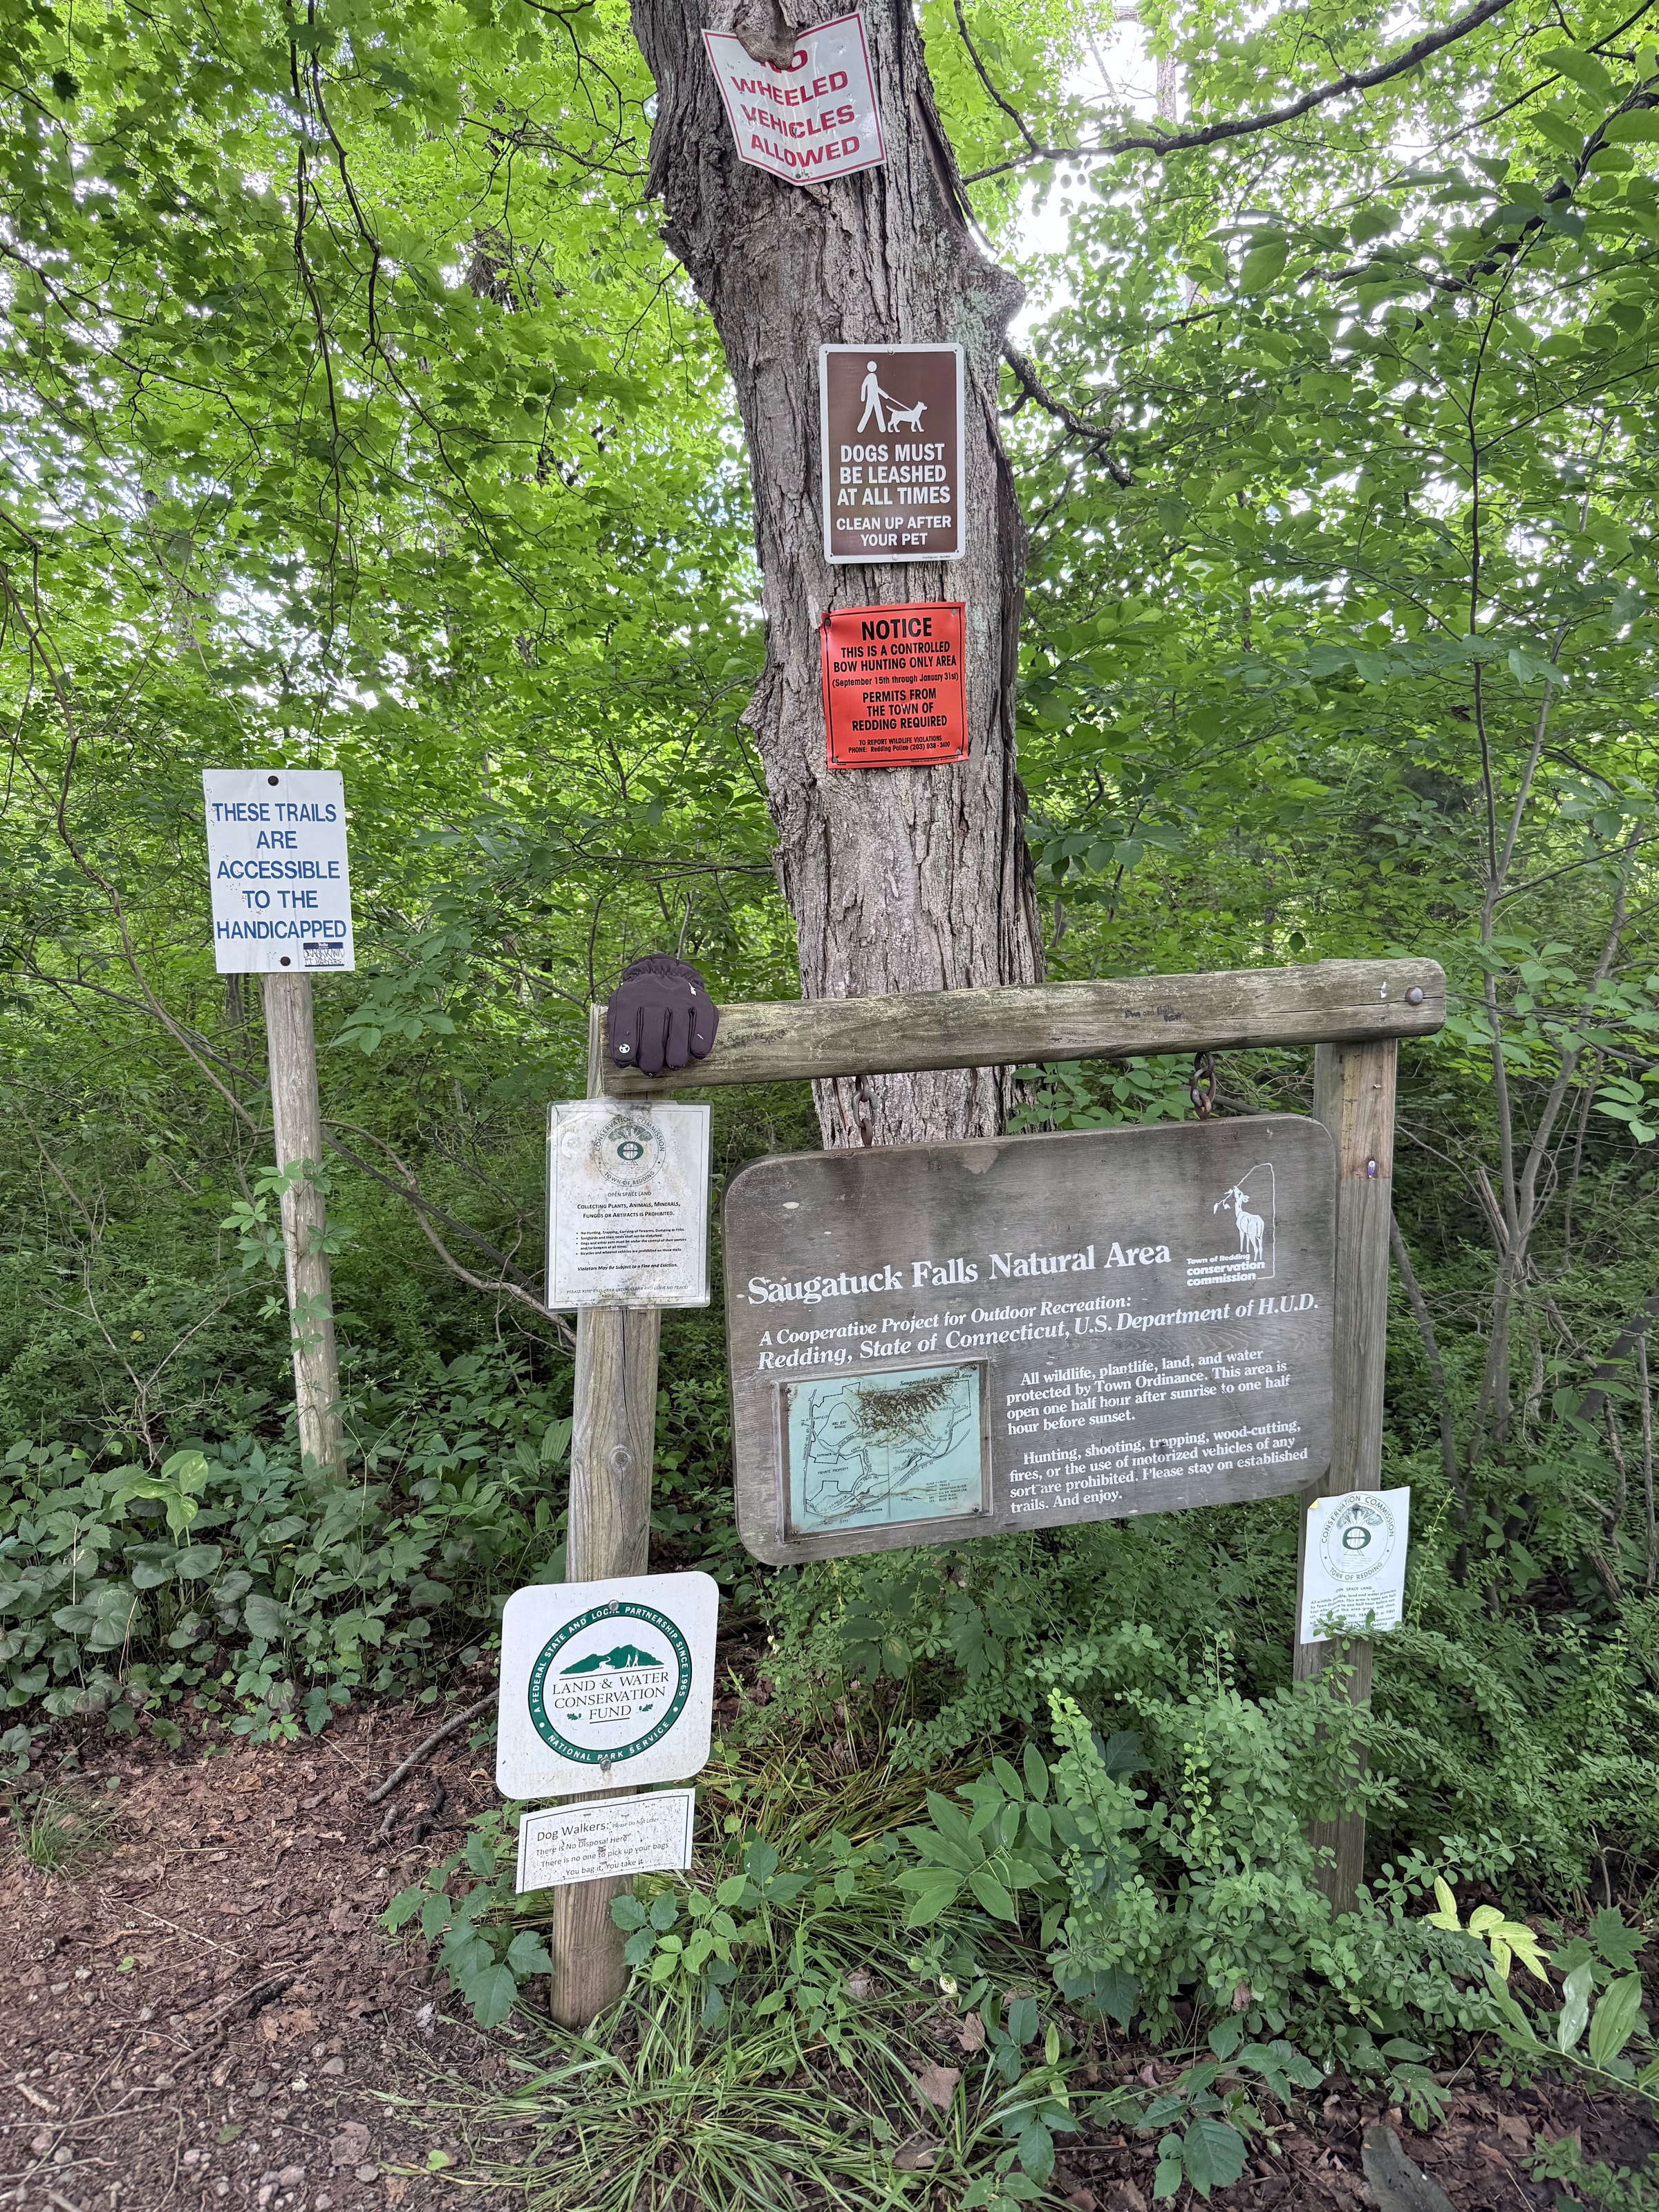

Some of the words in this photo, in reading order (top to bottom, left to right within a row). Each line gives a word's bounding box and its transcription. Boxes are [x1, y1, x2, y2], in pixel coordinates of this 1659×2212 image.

[731, 71, 848, 106] WHEELED
[740, 104, 854, 139] VEHICLES
[751, 134, 860, 168] ALLOWED
[841, 444, 888, 462] DOGS
[895, 443, 944, 462] MUST
[840, 467, 863, 484] BE
[868, 465, 946, 483] LEASHED
[836, 488, 857, 505] AT
[862, 487, 893, 505] ALL
[897, 486, 950, 505] TIMES
[836, 518, 881, 530] CLEAN
[885, 517, 903, 529] UP
[907, 516, 951, 529] AFTER
[861, 534, 897, 546] YOUR
[901, 533, 928, 545] PET
[861, 617, 932, 641] NOTICE
[841, 646, 863, 658] THIS
[867, 646, 877, 657] IS
[881, 645, 888, 656] A
[890, 641, 950, 655] CONTROLLED
[834, 661, 857, 673] BOW
[861, 658, 906, 671] HUNTING
[910, 657, 933, 668] ONLY
[936, 655, 957, 666] AREA
[832, 675, 872, 688] (September
[875, 675, 890, 684] 15th
[892, 673, 918, 684] through
[919, 673, 943, 683] January
[944, 672, 959, 681] 31st)
[863, 690, 906, 703] PERMITS
[910, 688, 936, 701] FROM
[867, 704, 885, 717] THE
[888, 703, 919, 715] TOWN
[921, 702, 934, 713] OF
[852, 718, 897, 731] REDDING
[900, 715, 947, 729] REQUIRED
[212, 803, 270, 822] THESE
[275, 803, 337, 822] TRAILS
[256, 830, 298, 849] ARE
[216, 860, 340, 879] ACCESSIBLE
[243, 890, 270, 908] TO
[277, 890, 319, 908] THE
[216, 920, 346, 939] HANDICAPPED
[748, 1264, 903, 1305] Saugatuck
[911, 1257, 978, 1288] Falls
[988, 1245, 1096, 1279] Natural
[1104, 1241, 1172, 1268] Area
[1186, 1261, 1266, 1275] conservation
[1186, 1272, 1257, 1286] commission
[759, 1331, 772, 1347] A
[776, 1321, 877, 1344] Cooperative
[881, 1315, 939, 1333] Project
[944, 1311, 966, 1327] for
[971, 1306, 1035, 1324] Outdoor
[1040, 1295, 1132, 1316] Recreation:
[758, 1346, 854, 1371] Redding,
[860, 1338, 912, 1359] State
[917, 1333, 937, 1353] of
[945, 1322, 1069, 1349] Connecticut,
[1074, 1316, 1112, 1335] U.S.
[1116, 1304, 1230, 1331] Department
[1235, 1298, 1255, 1318] of
[1257, 1293, 1319, 1315] H.U.D.
[1020, 1371, 1040, 1386] All
[1043, 1367, 1096, 1383] wildlife,
[1099, 1360, 1159, 1379] plantlife,
[1161, 1356, 1194, 1371] land,
[1198, 1352, 1222, 1366] and
[1226, 1349, 1264, 1362] water
[1006, 1385, 1071, 1406] protected
[1075, 1382, 1091, 1398] by
[1094, 1378, 1132, 1394] Town
[1135, 1371, 1208, 1388] Ordinance.
[1211, 1367, 1241, 1380] This
[1244, 1365, 1273, 1376] area
[1276, 1360, 1287, 1373] is
[1006, 1406, 1040, 1421] open
[1043, 1402, 1067, 1415] one
[1071, 1394, 1096, 1411] half
[1100, 1393, 1132, 1407] hour
[1135, 1389, 1165, 1404] after
[1170, 1385, 1217, 1400] sunrise
[1221, 1382, 1235, 1394] to
[1237, 1380, 1262, 1392] one
[1265, 1374, 1291, 1389] half
[1008, 1420, 1039, 1436] hour
[1043, 1416, 1086, 1431] before
[1089, 1409, 1136, 1425] sunset.
[1321, 1495, 1360, 1544] CONSERVATION
[1365, 1497, 1394, 1537] COMMISSION
[1329, 1567, 1342, 1579] TOWN
[1356, 1562, 1383, 1580] REDDING
[568, 1618, 587, 1634] AND
[625, 1606, 678, 1639] PARTNERSHIP
[545, 1633, 566, 1658] STATE
[675, 1642, 688, 1669] SINCE
[532, 1662, 546, 1703] FEDERAL
[552, 1680, 595, 1695] LAND
[601, 1678, 612, 1689] &
[620, 1671, 669, 1687] WATER
[679, 1673, 688, 1697] 1965
[554, 1686, 666, 1709] CONSERVATION
[589, 1705, 632, 1720] FUND
[548, 1734, 591, 1761] NATIONAL
[597, 1750, 624, 1760] PARK
[629, 1721, 669, 1754] SERVICE
[537, 1830, 559, 1841] Dog
[561, 1821, 609, 1836] Walkers:
[536, 1847, 556, 1856] There
[579, 1837, 608, 1848] Disposal
[541, 1859, 561, 1868] There
[608, 1848, 622, 1857] pick
[624, 1848, 633, 1857] up
[635, 1845, 651, 1854] your
[653, 1842, 669, 1851] bags
[581, 1866, 594, 1875] bag
[621, 1859, 636, 1867] take
